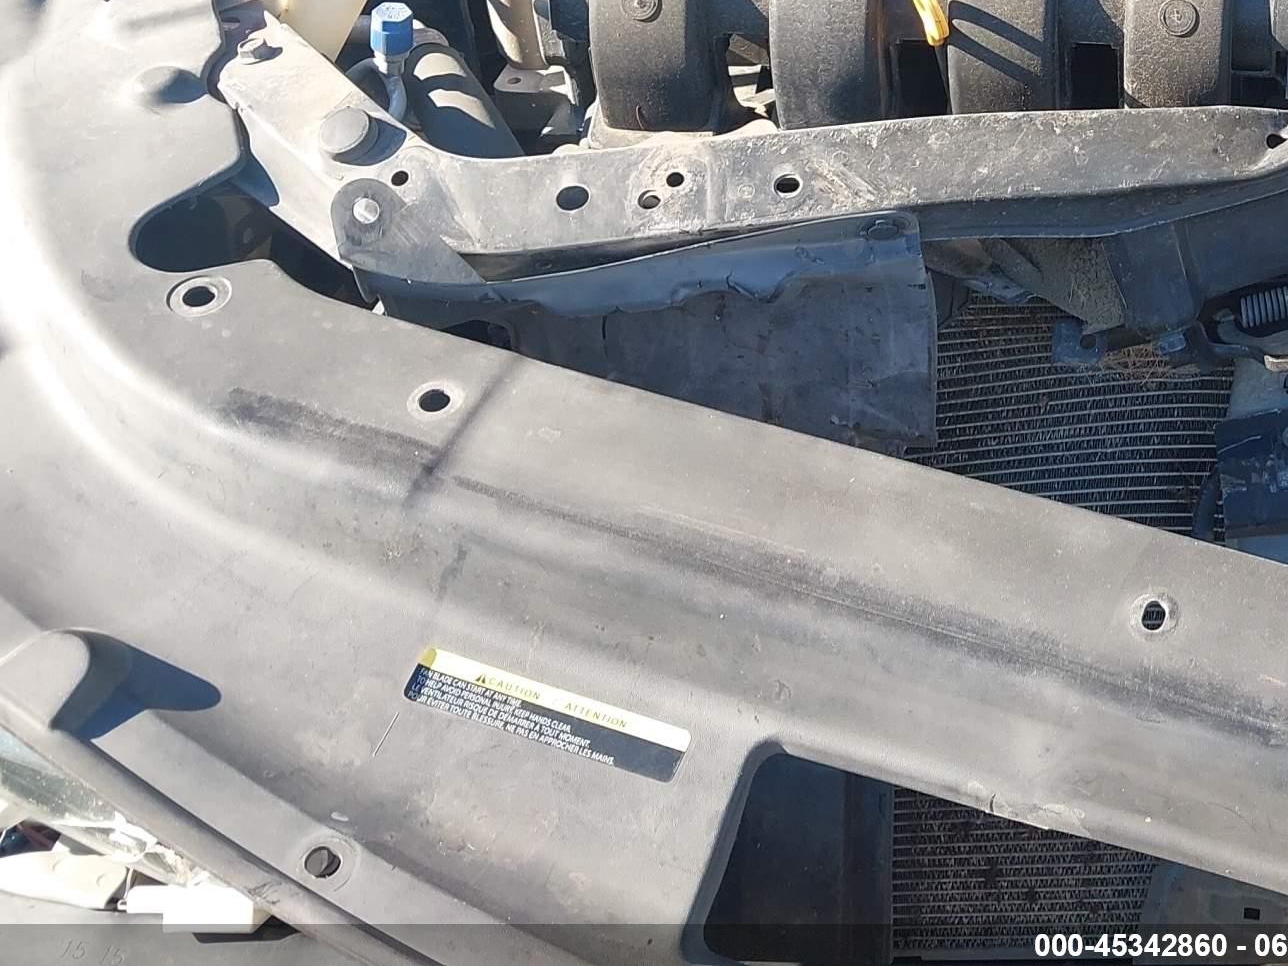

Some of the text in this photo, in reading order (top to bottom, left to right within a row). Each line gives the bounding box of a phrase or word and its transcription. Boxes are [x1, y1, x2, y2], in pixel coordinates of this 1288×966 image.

[417, 675, 425, 684] TO
[425, 679, 443, 690] HELP
[441, 685, 461, 696] AVOID
[461, 690, 490, 707] PERSONAL
[514, 708, 530, 718] KEEP
[529, 712, 552, 726] HANDS
[420, 667, 434, 679] FAN
[432, 672, 452, 685] BLADE
[452, 679, 467, 690] CAN
[466, 683, 486, 695] START
[493, 692, 508, 703] ANY
[489, 678, 627, 728] CAUTION ATTENTION
[408, 690, 427, 703] POUR
[449, 704, 473, 719] TOUTE
[505, 723, 516, 734] NE
[516, 727, 529, 737] PAS
[528, 730, 540, 740] EN
[538, 735, 580, 754] APPROCHER
[578, 748, 592, 758] LES
[420, 686, 464, 705] VENTILATEUR
[464, 700, 488, 715] RISQUE
[487, 708, 498, 718] DE
[541, 725, 560, 738] TOUT
